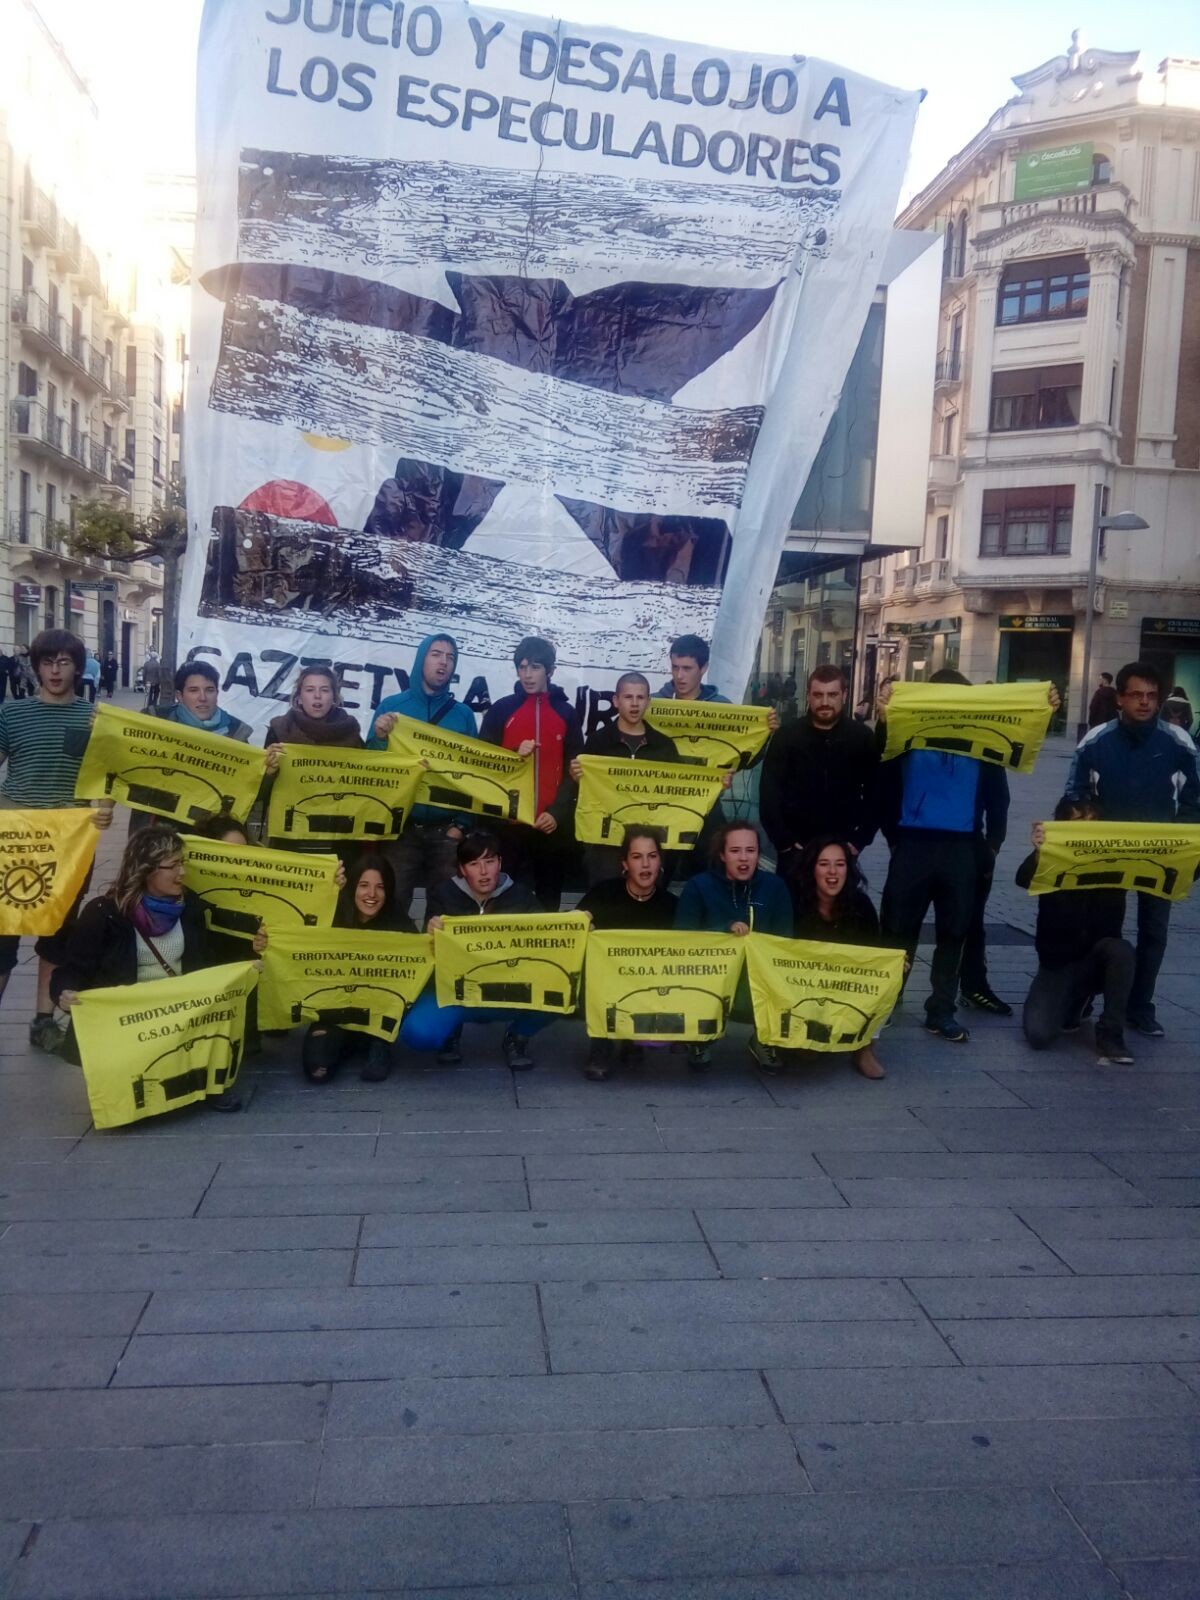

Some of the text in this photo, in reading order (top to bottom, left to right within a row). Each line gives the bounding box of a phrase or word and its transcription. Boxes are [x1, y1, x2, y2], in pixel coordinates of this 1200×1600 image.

[265, 0, 851, 126] JUICIO Y DESALOJO A
[266, 48, 841, 186] LOS ESPECULADORES
[122, 727, 201, 752] ERROTXAPEAKO
[171, 752, 238, 776] AURRERA!!
[291, 759, 363, 770] ERROTXAPEAKO
[608, 767, 677, 779] ERROTXAPEAKO
[338, 775, 400, 789] AURRERA!!
[653, 785, 710, 797] AURRERA!!
[0, 830, 51, 840] RDUA DA
[188, 851, 326, 879] ERROTXAPEAKO GAZTETXEA
[245, 874, 314, 893] AURRERA!!
[453, 923, 585, 935] ERROTXAPEAKO GAZTETXEA
[466, 938, 576, 952] C.S.O.A. AURRERA!!
[607, 947, 737, 957] ERROTXAPEAKO GAZTETXEA
[292, 952, 427, 964] ERROTXAPEAKO GAZTETXEA
[772, 957, 841, 973] ERROTXAPEAKO
[304, 967, 416, 980] C.S.O.A. AURRERA!!
[618, 964, 728, 976] C.S.O.A. AURRERA!!
[817, 978, 879, 996] AURRERA!!
[119, 996, 212, 1027] ERROTXAPEAKO
[137, 1023, 184, 1042] C.S.O.A.
